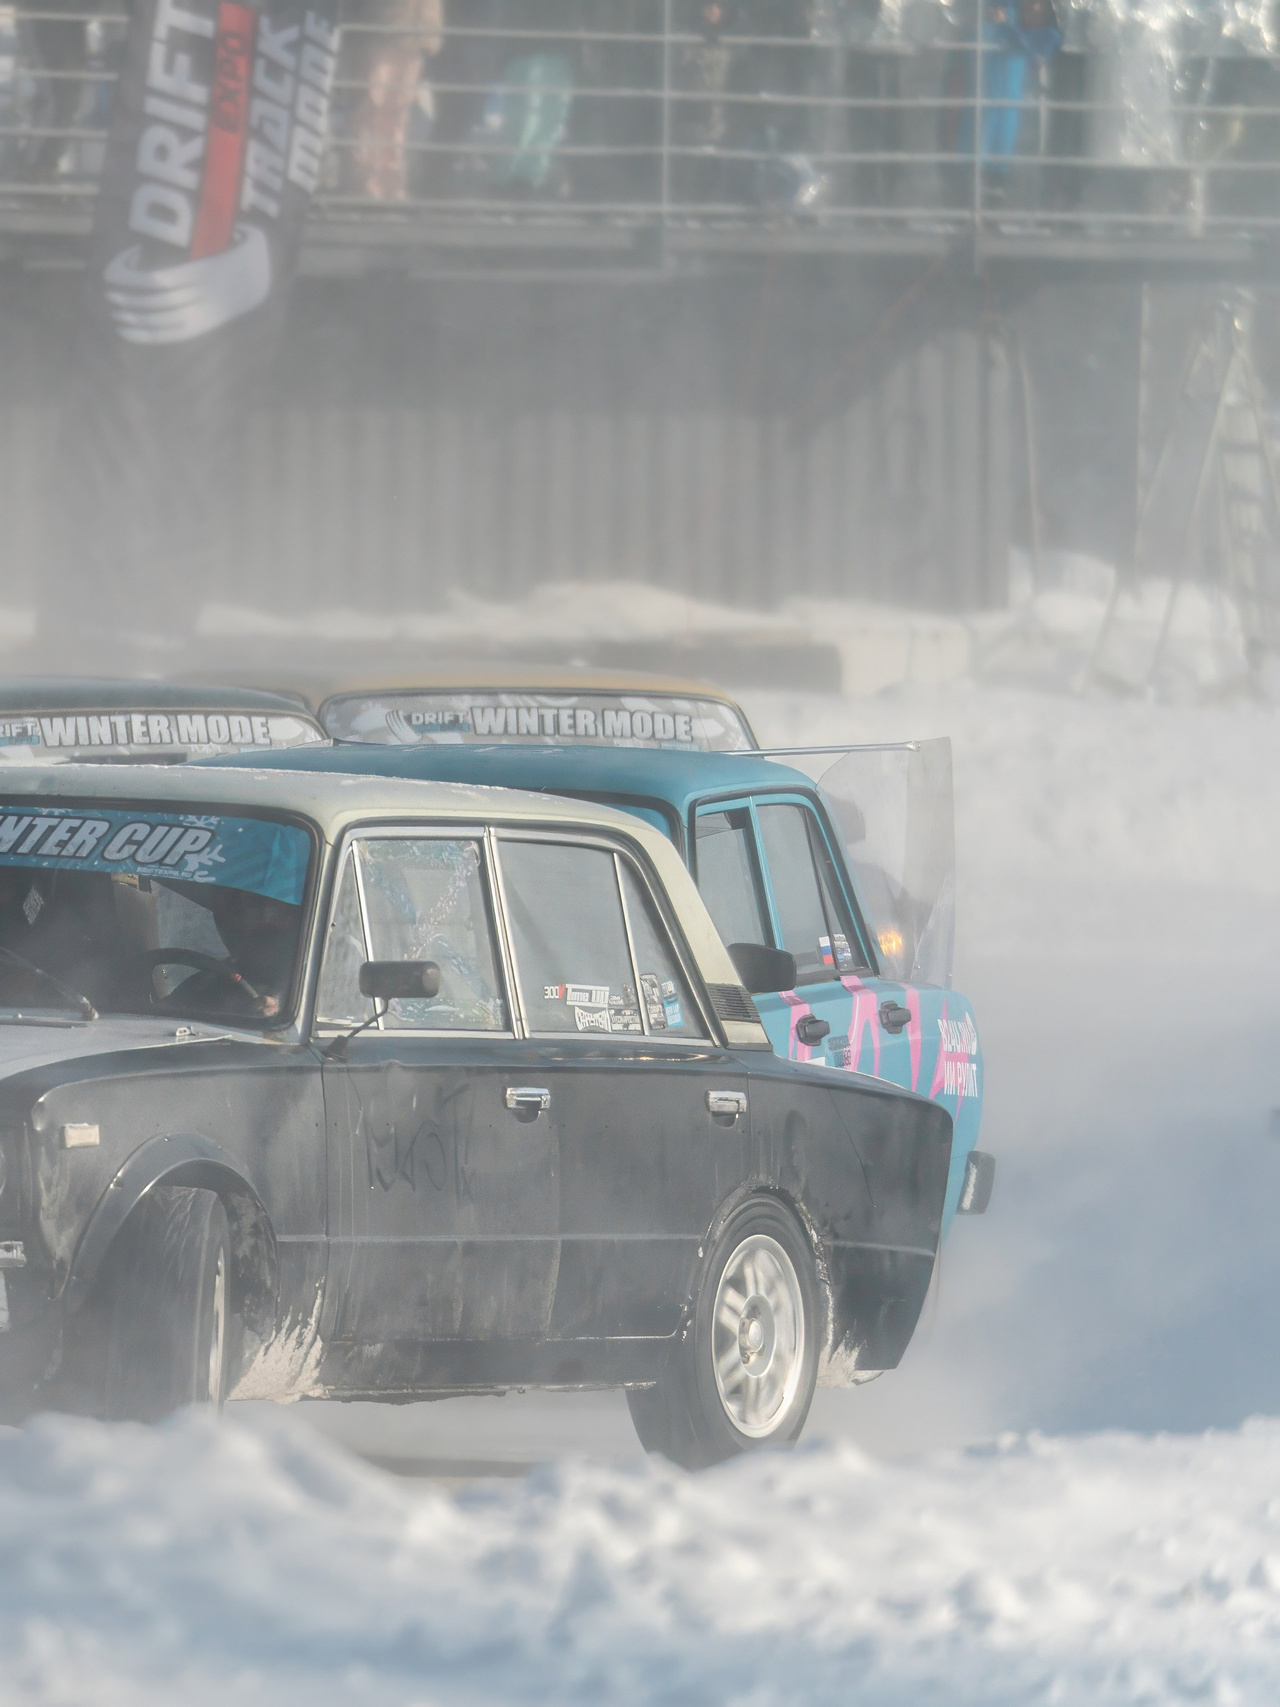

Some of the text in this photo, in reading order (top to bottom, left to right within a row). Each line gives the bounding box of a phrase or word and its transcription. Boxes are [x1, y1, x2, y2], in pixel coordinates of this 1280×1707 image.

[128, 0, 214, 248] DRIFT
[241, 14, 300, 219] TRACK
[39, 714, 172, 748] WINTER
[175, 713, 272, 746] MODE
[411, 706, 693, 742] DRIFT WINTER MODE
[102, 821, 215, 867] CUP
